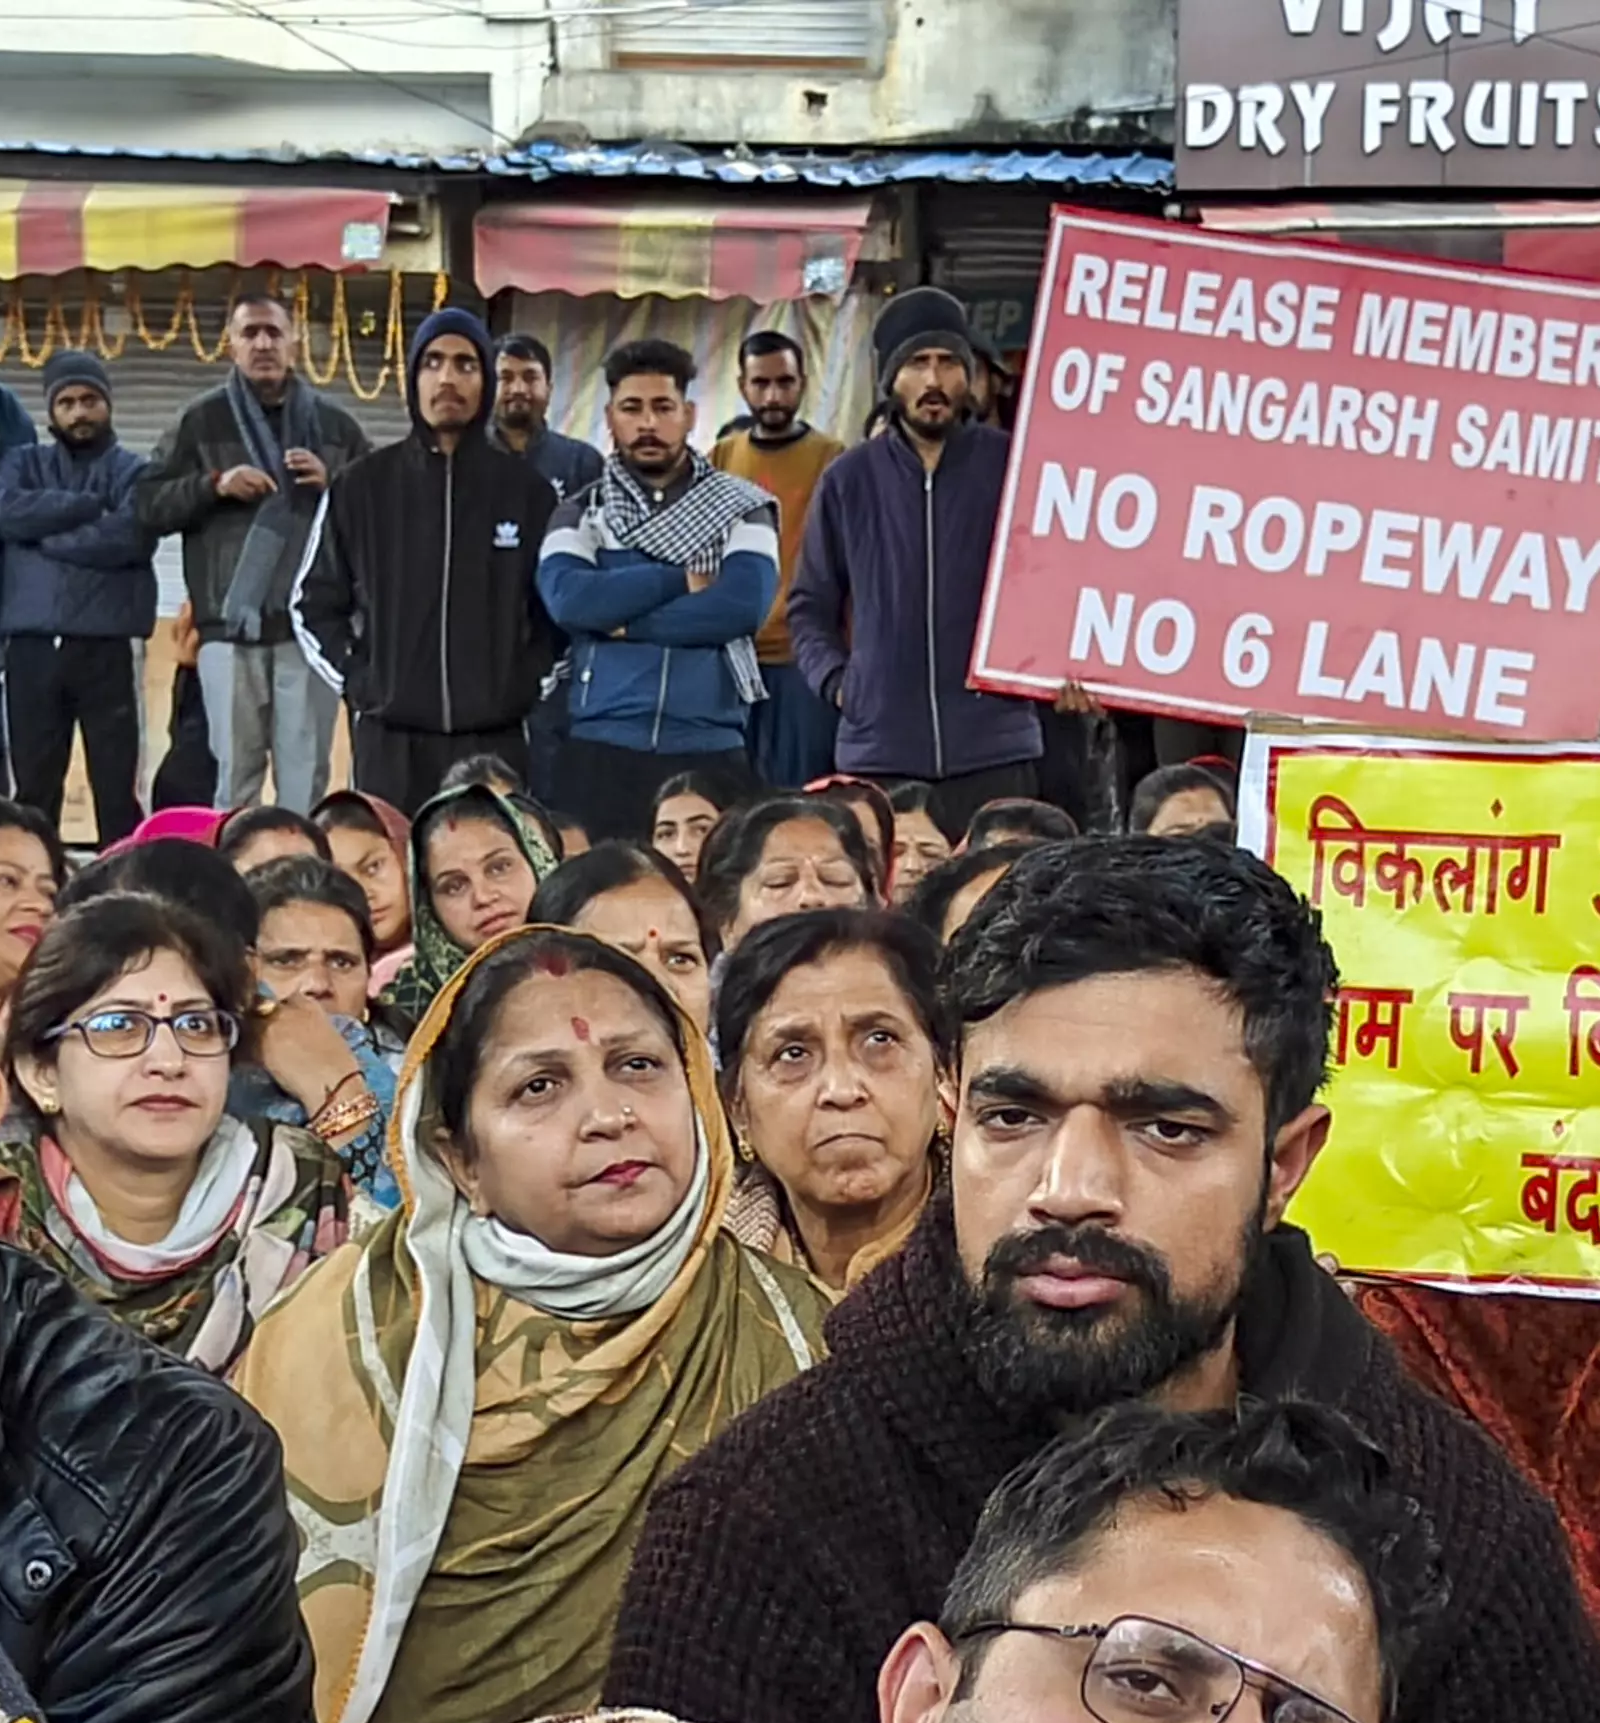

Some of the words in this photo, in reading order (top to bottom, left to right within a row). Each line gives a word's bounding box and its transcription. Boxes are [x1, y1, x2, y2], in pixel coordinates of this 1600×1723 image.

[1185, 81, 1336, 155] DRY
[1064, 253, 1337, 350] RELEASE
[1050, 347, 1123, 414] OF
[1135, 361, 1439, 461] SANGARSH
[1032, 461, 1157, 550] NO
[1069, 587, 1196, 675] NO
[1223, 612, 1273, 689] 6
[1297, 620, 1535, 727] LANE
[1308, 795, 1561, 914] विकलांग
[1448, 992, 1530, 1078] पर
